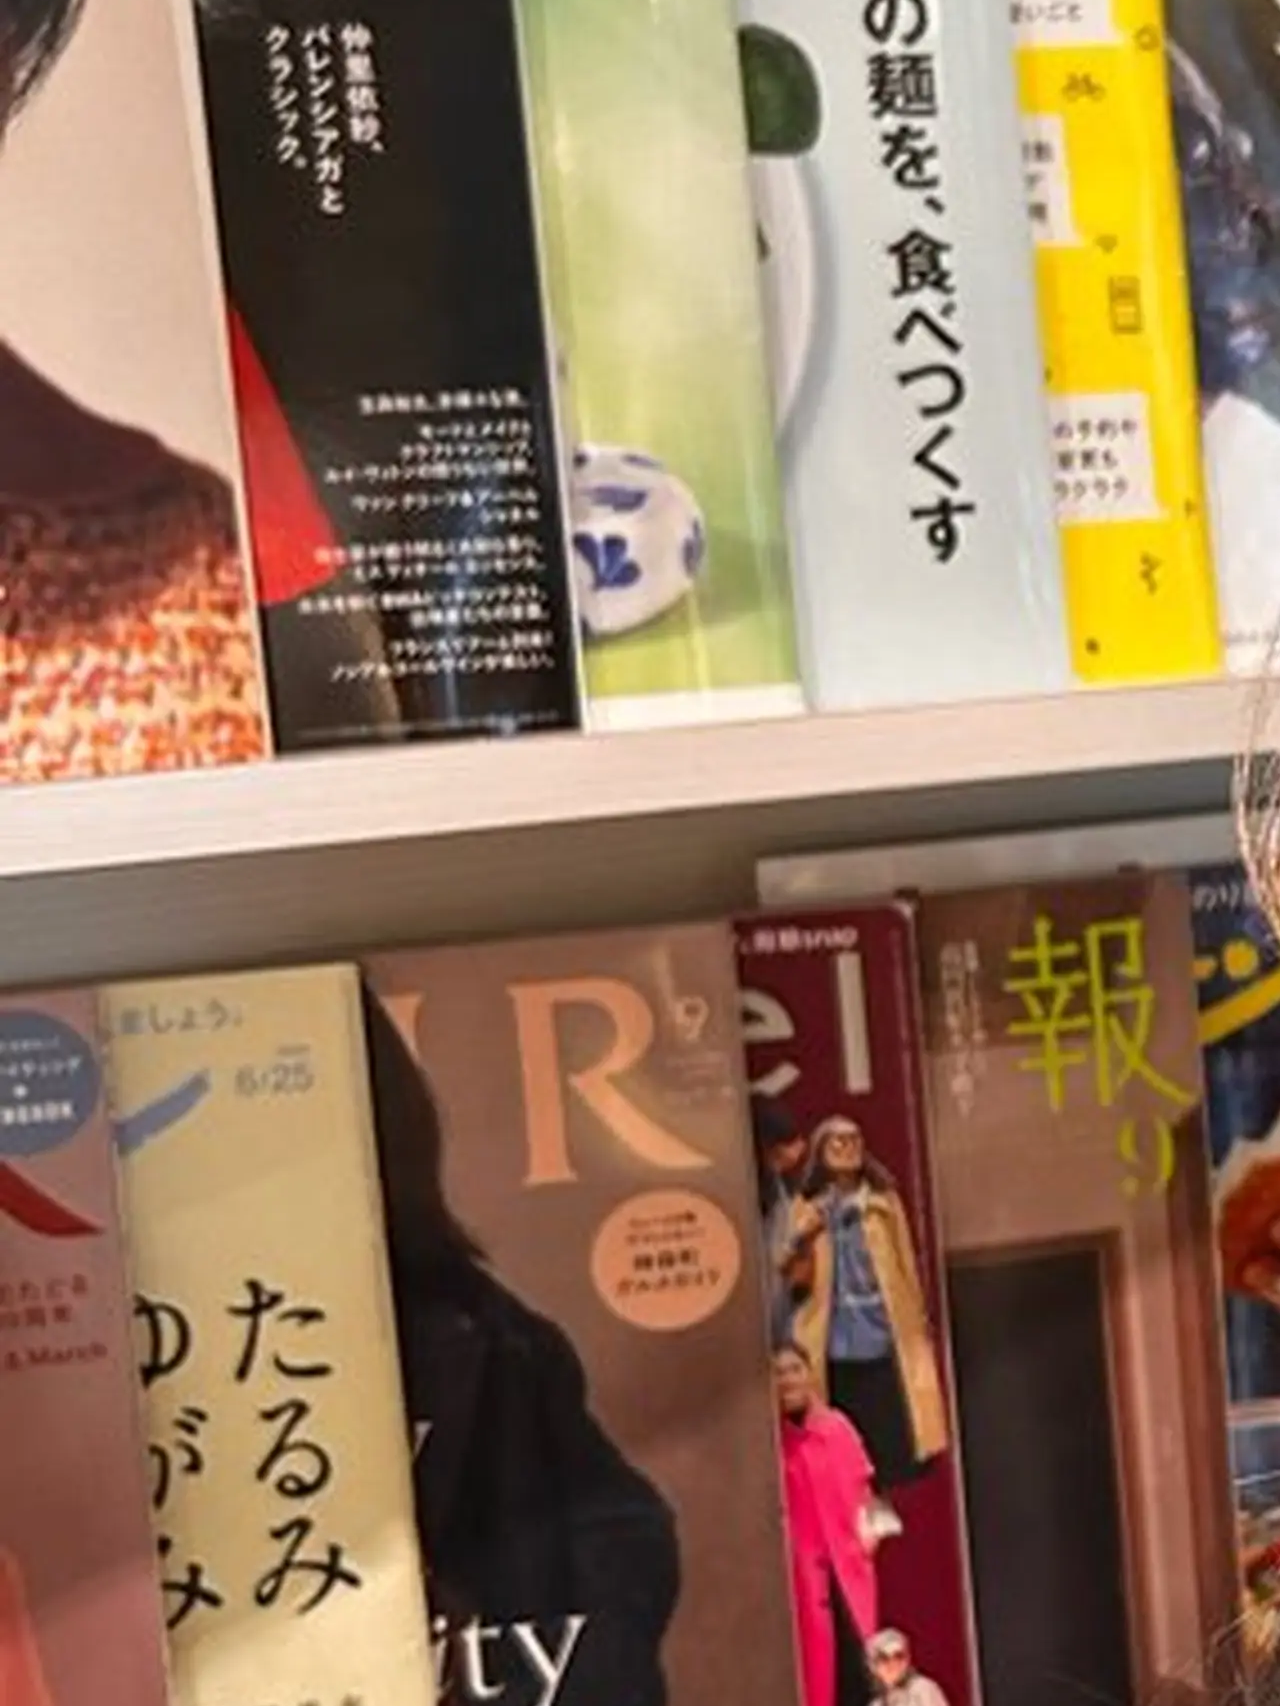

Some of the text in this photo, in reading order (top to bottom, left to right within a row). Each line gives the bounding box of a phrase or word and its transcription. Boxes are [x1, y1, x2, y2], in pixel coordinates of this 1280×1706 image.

[265, 26, 307, 169] クラシック。
[301, 25, 345, 214] バレンシアガと
[506, 974, 714, 1185] R
[1004, 915, 1198, 1109] 報
[226, 1276, 360, 1619] たるみ
